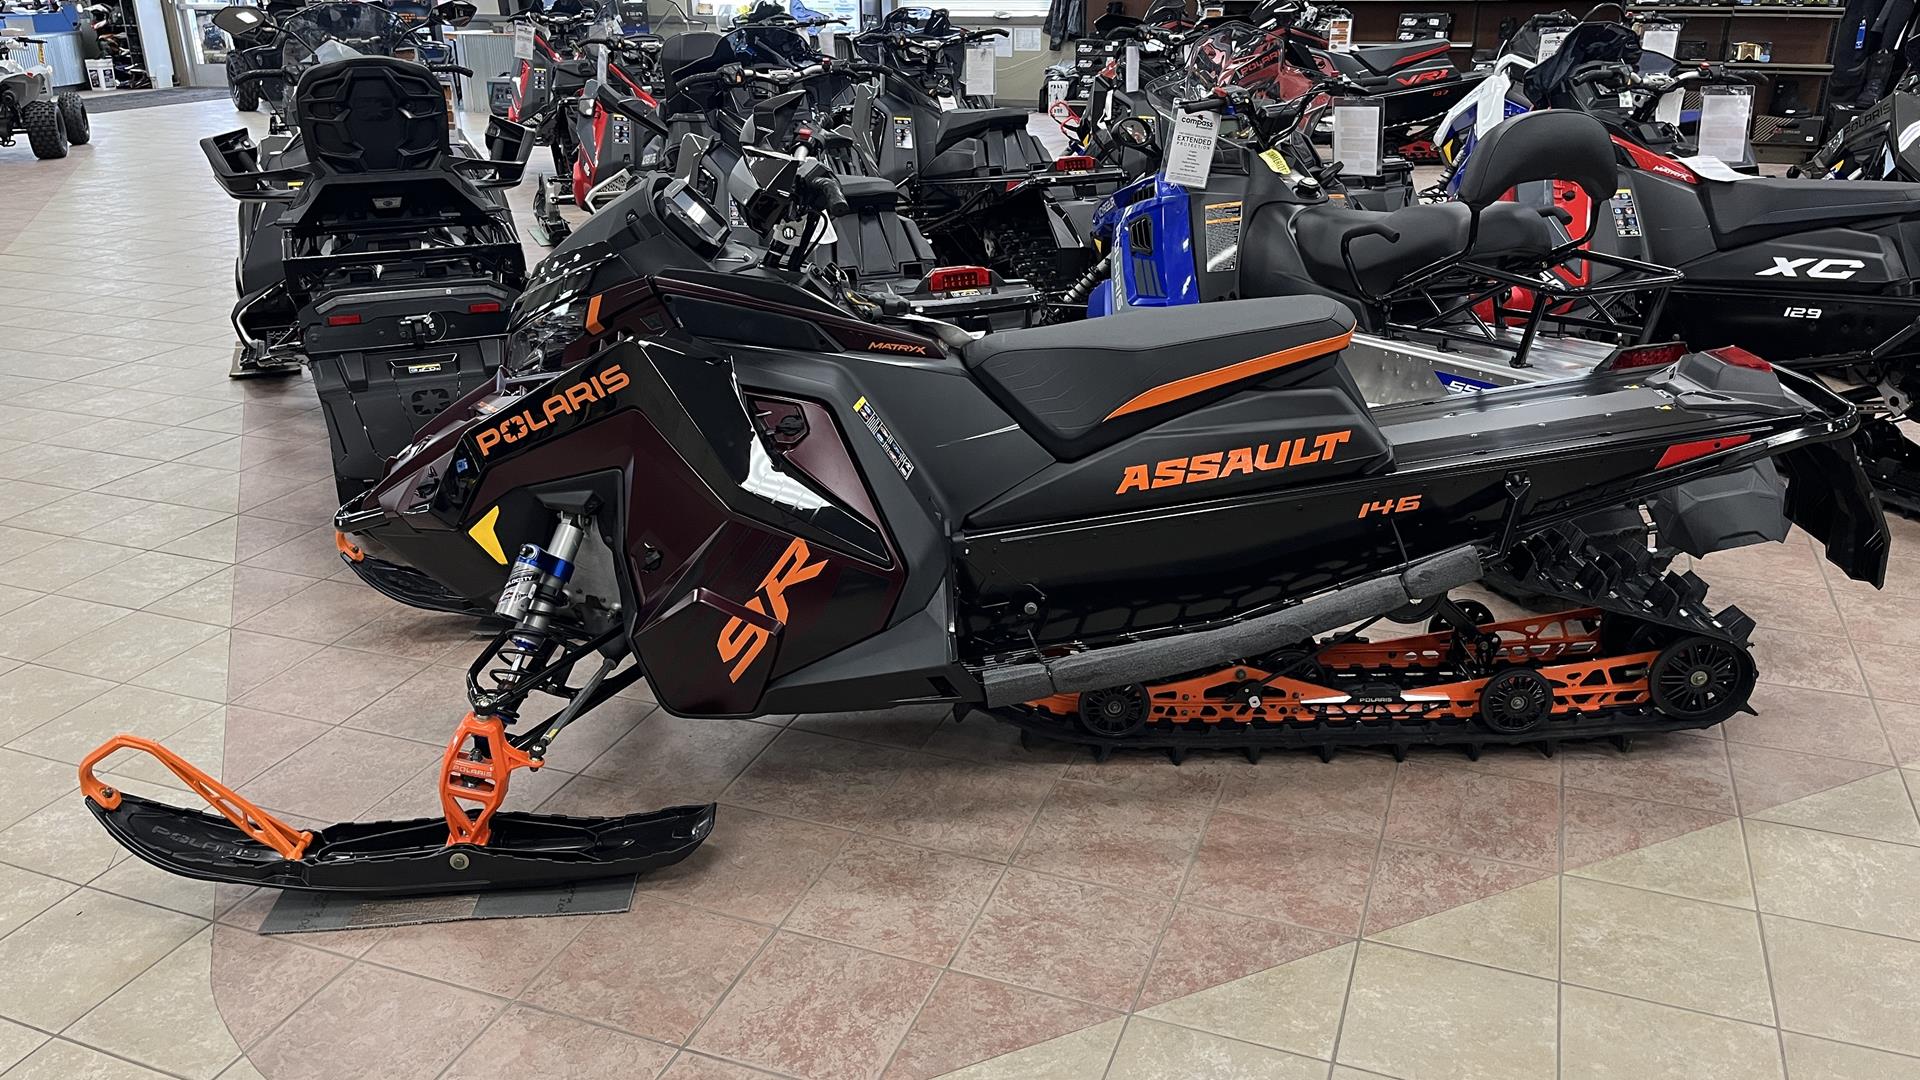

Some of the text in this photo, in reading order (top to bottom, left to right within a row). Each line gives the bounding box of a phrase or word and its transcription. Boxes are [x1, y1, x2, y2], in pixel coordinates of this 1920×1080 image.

[1395, 69, 1449, 86] VR1
[1181, 117, 1214, 128] compass
[1844, 103, 1893, 135] POLARIS
[1176, 141, 1211, 150] PROTECTION
[1177, 135, 1212, 146] EXTENDED
[1652, 166, 1689, 181] MATRYX
[1113, 224, 1124, 311] POLARIS
[1755, 257, 1866, 280] XC
[1783, 307, 1822, 319] 129
[867, 341, 927, 355] MATRYX
[1447, 380, 1488, 393] 55
[476, 364, 631, 456] POLARIS
[1116, 430, 1351, 494] ASSAULT
[1358, 495, 1422, 519] 146
[452, 764, 492, 777] POLARIS
[152, 825, 260, 858] POLARIS
